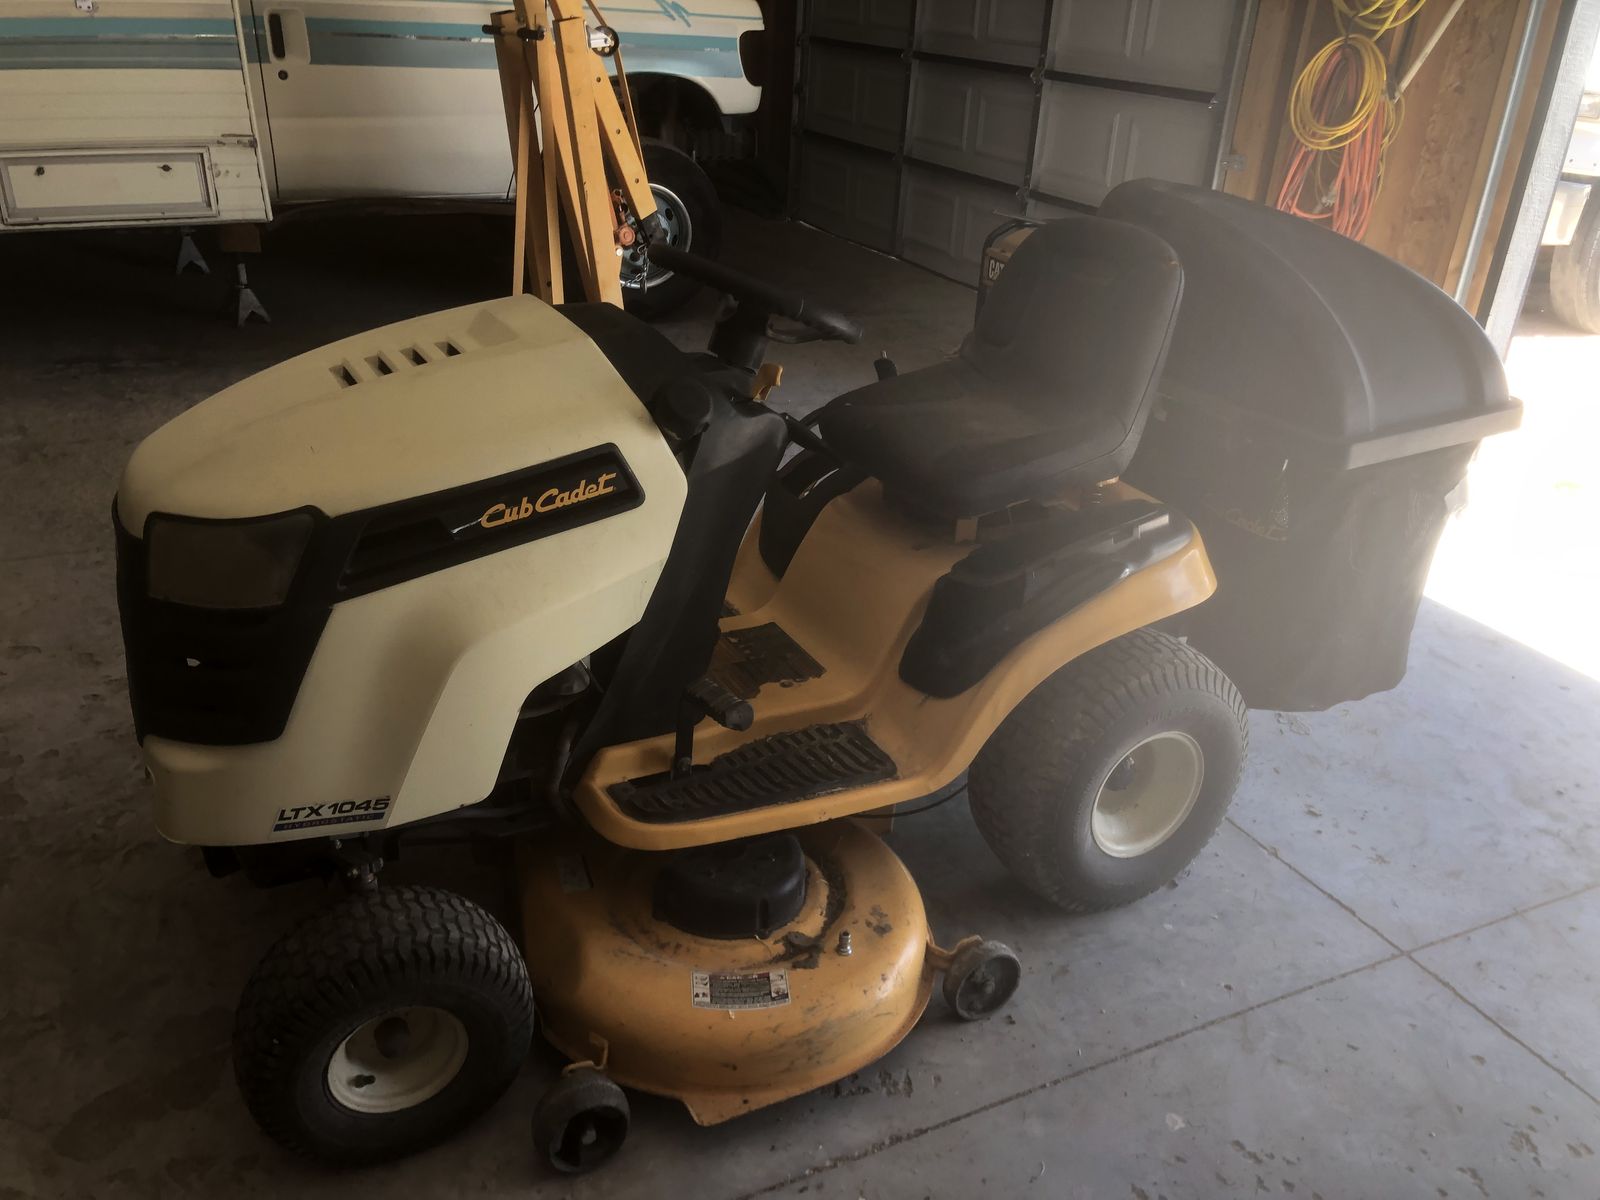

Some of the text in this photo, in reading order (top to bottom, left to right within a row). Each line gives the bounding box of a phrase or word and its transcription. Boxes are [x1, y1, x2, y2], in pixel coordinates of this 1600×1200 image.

[480, 472, 617, 528] Cub Cadet
[278, 799, 390, 821] LTX 1045
